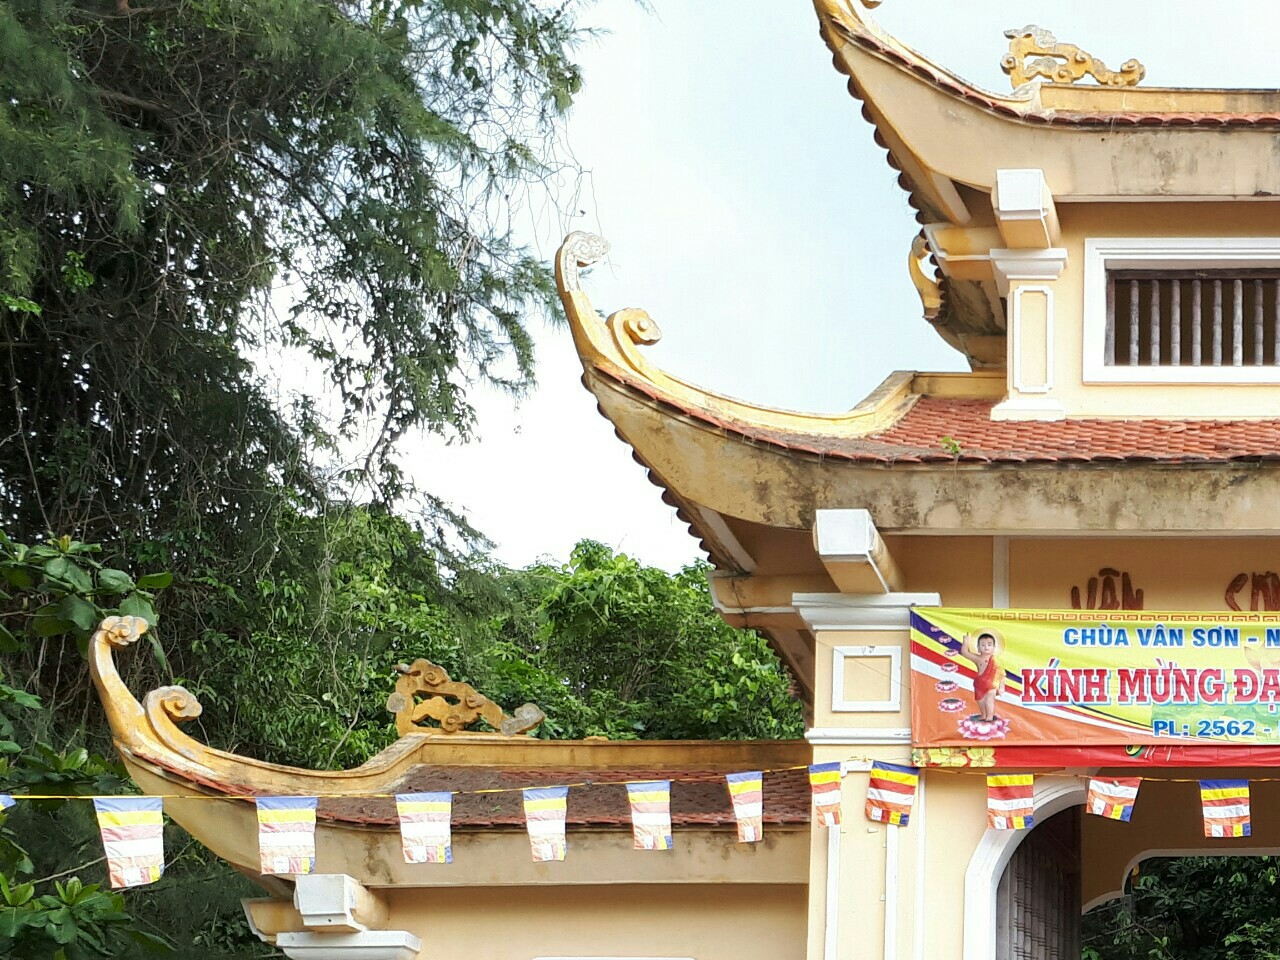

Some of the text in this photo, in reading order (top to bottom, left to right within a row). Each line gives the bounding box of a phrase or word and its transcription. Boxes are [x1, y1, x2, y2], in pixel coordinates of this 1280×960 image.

[1064, 623, 1129, 646] CHÙA
[1137, 624, 1184, 647] VÂN
[1192, 625, 1238, 647] SƠN
[1020, 657, 1108, 703] KÍNH
[1117, 657, 1225, 703] MỪNG
[1153, 720, 1190, 737] PL:
[1197, 719, 1255, 737] 2562
